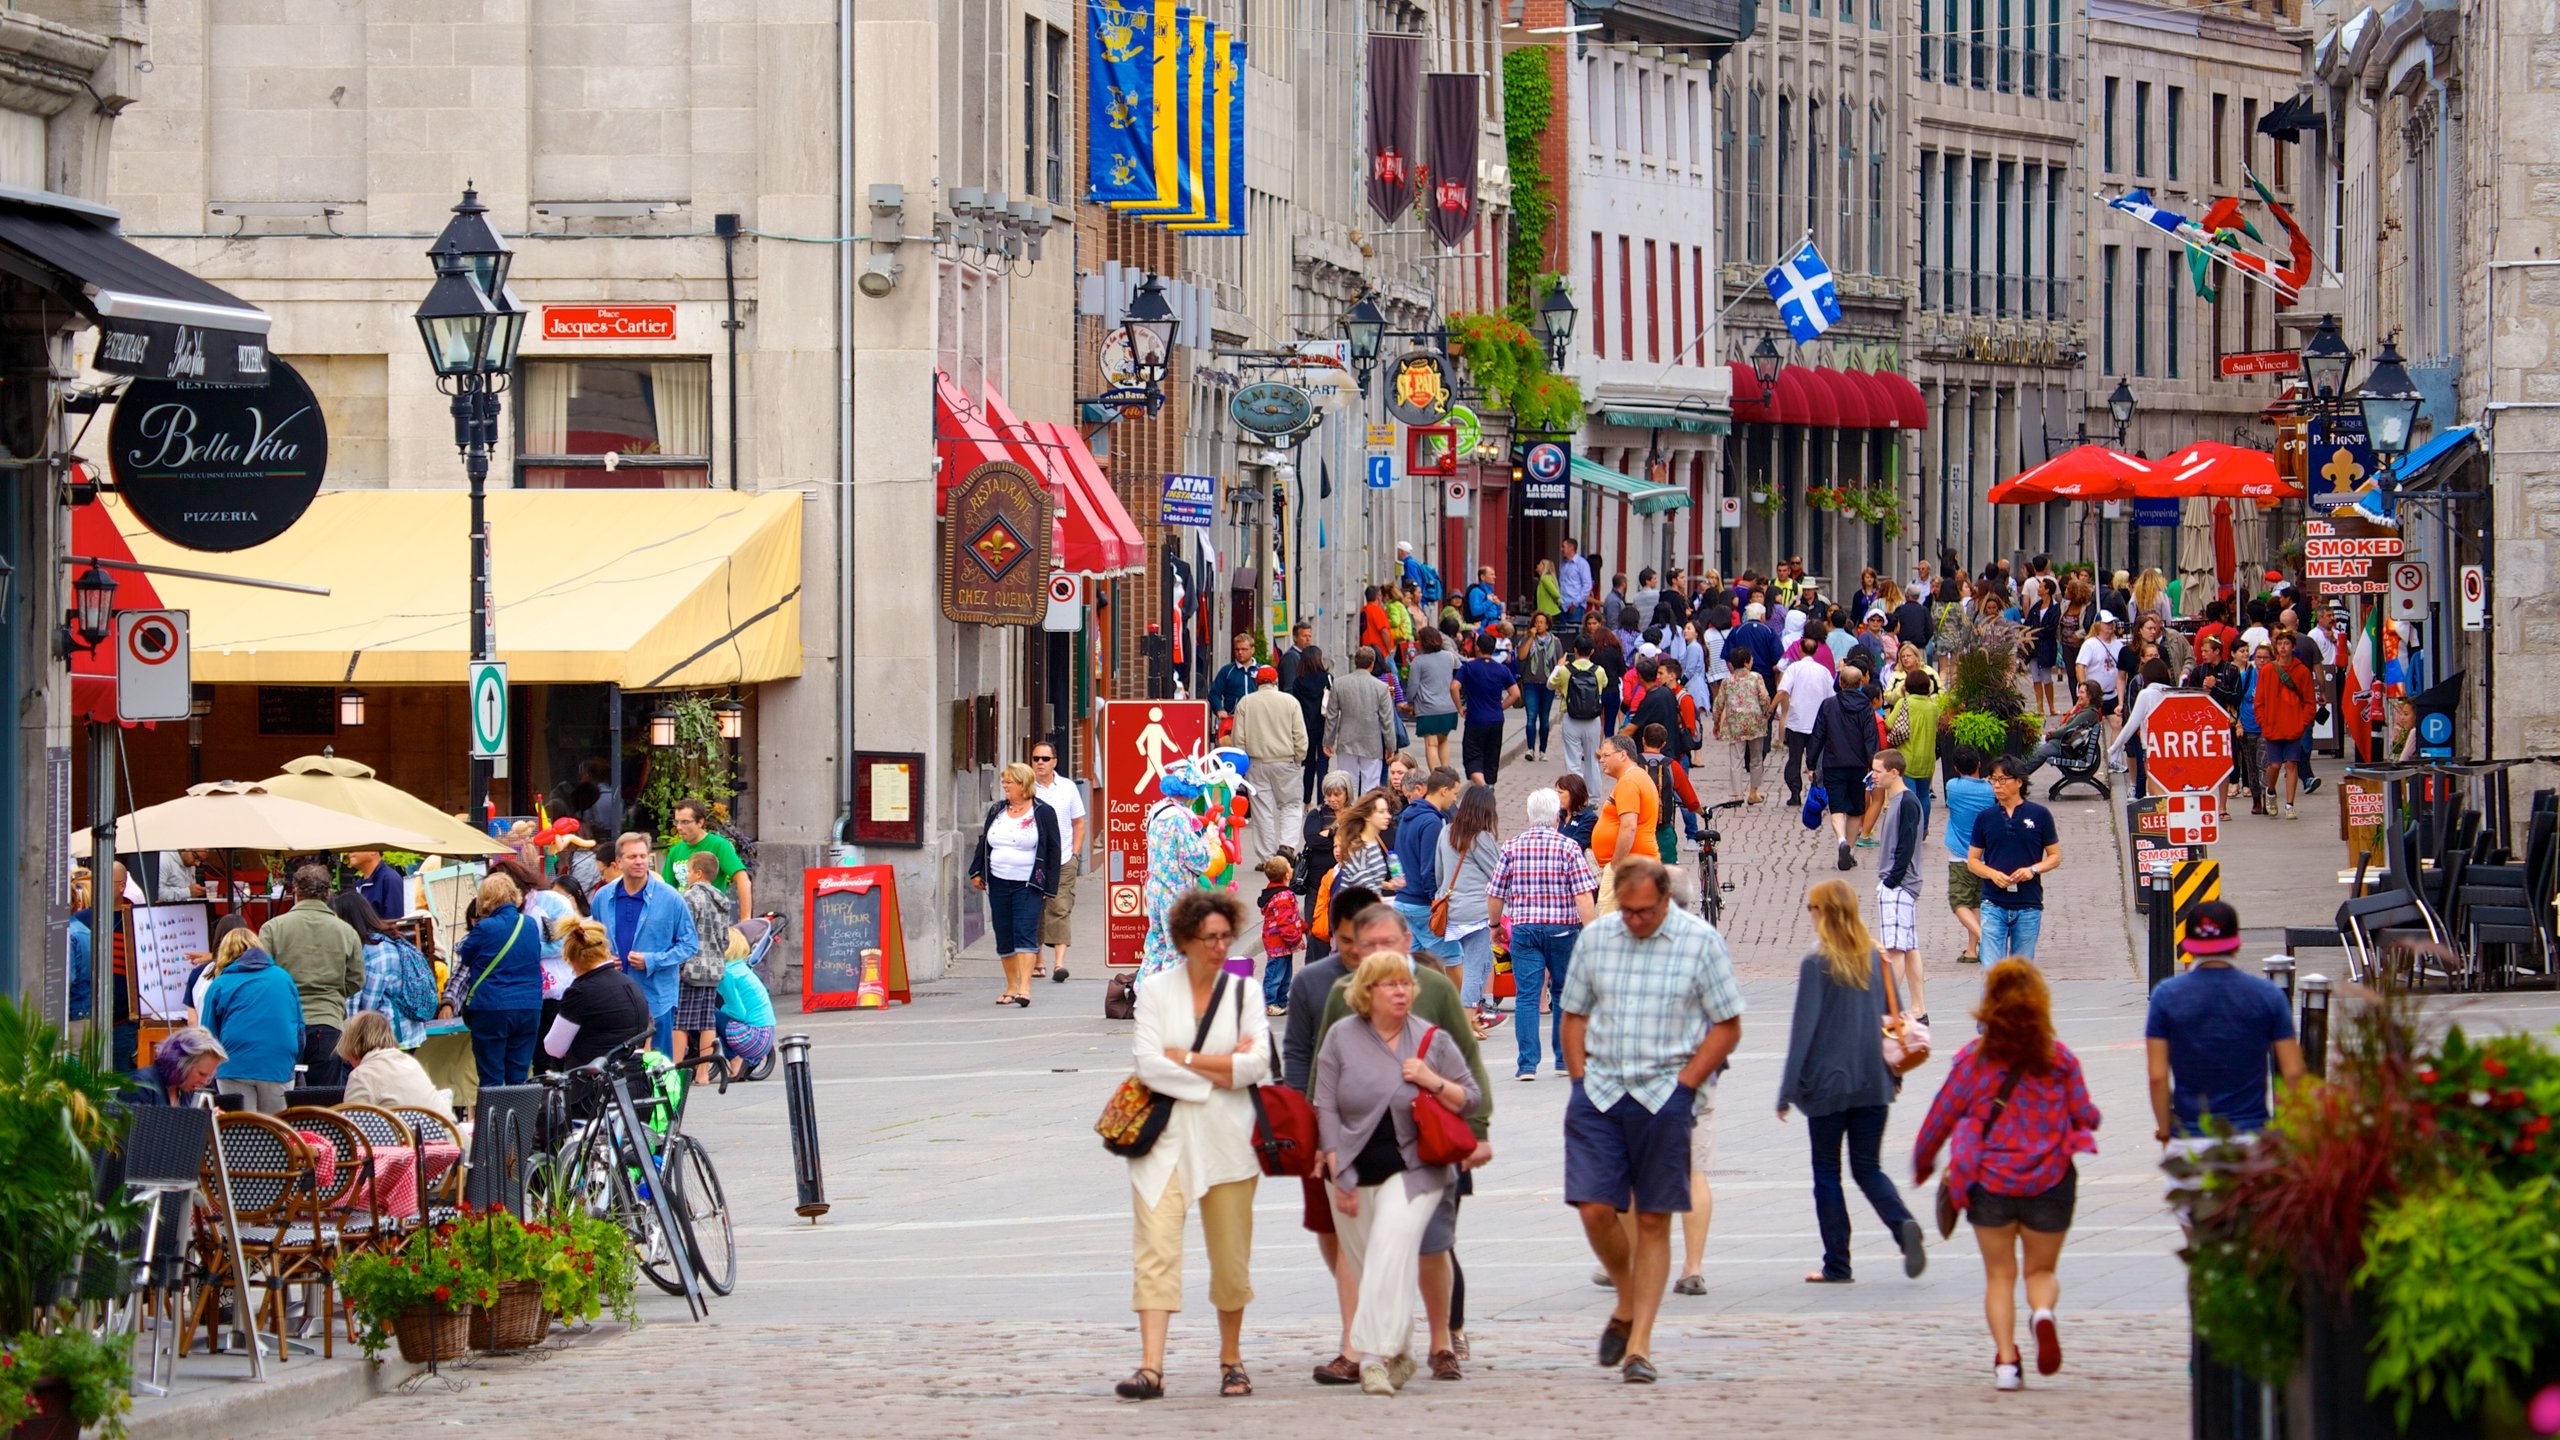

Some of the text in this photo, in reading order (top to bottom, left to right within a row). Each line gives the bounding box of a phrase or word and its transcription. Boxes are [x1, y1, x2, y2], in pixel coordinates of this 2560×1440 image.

[597, 309, 620, 319] Place
[549, 318, 668, 339] Jacques-Cartier
[2232, 360, 2289, 372] Saint-Vincent
[128, 403, 312, 469] Bella Vita
[226, 471, 265, 479] ITALIENNE
[1170, 477, 1209, 493] ATM
[1526, 483, 1565, 493] LA CAGE
[969, 479, 1033, 514] RESTAURANT
[183, 511, 259, 522] PIZZERIA
[1524, 508, 1567, 518] RESTO BAR
[2134, 508, 2178, 519] l'empreinte
[2307, 521, 2335, 536] Mr.
[2305, 538, 2404, 558] SMOKED
[2306, 559, 2372, 578] MEAT
[2320, 581, 2389, 594] Resto Bar
[958, 588, 1033, 608] CHEZ QUEUX
[2147, 725, 2231, 758] ARRÊT
[2346, 785, 2364, 793] Mr.
[2348, 793, 2384, 804] SMOK
[1110, 799, 1140, 813] Zone
[1110, 818, 1136, 832] Rue
[2141, 815, 2168, 829] SLEE
[1123, 838, 1130, 850] h
[1133, 839, 1139, 850] à
[2136, 840, 2155, 850] Mr.
[1129, 852, 1145, 865] mai
[817, 877, 874, 889] Budweiser
[1126, 869, 1148, 884] sep
